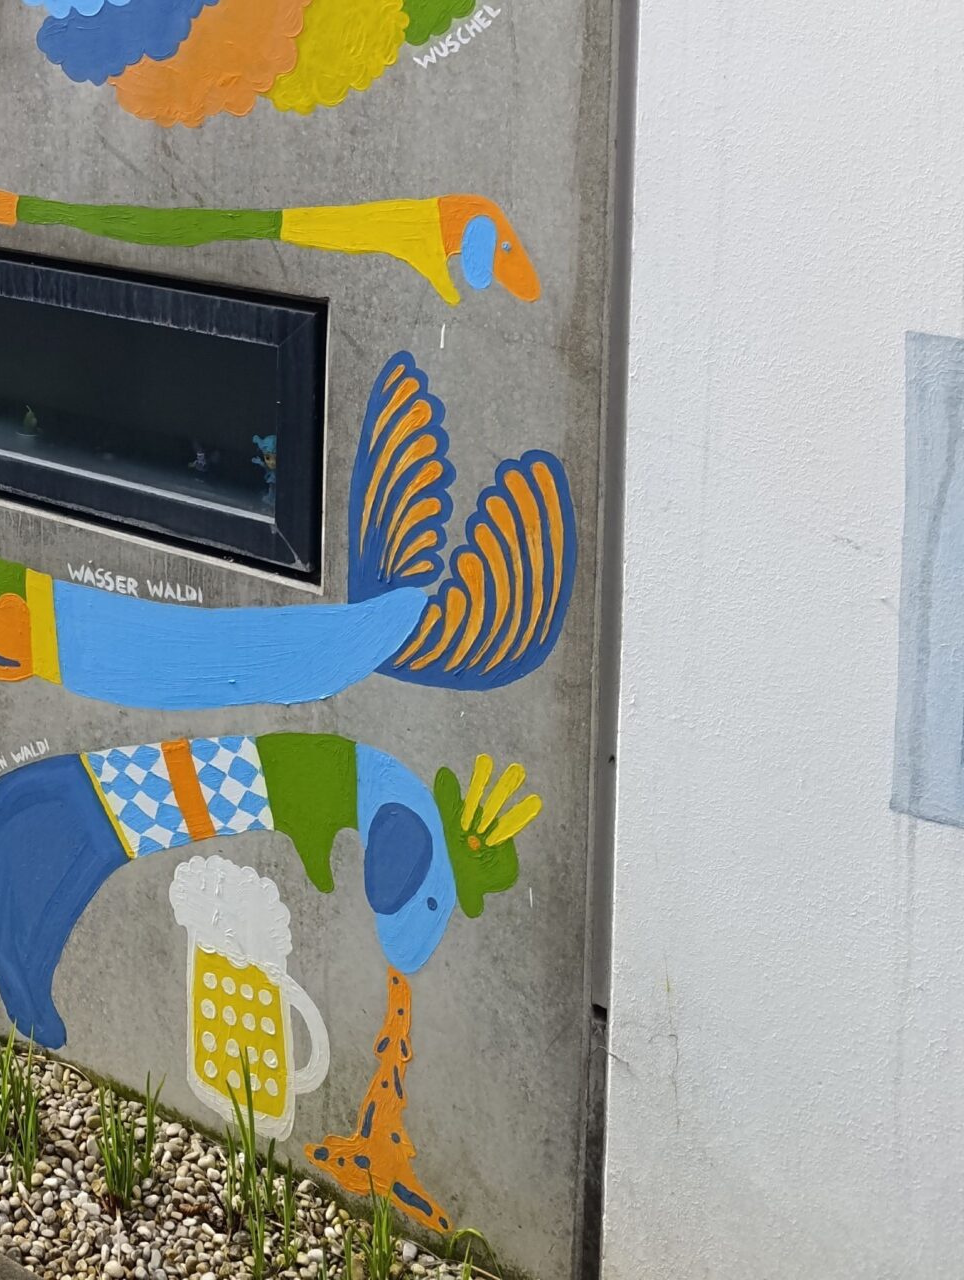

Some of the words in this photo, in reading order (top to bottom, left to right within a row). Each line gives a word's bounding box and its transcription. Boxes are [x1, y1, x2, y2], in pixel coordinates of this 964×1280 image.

[412, 4, 502, 69] WUSCHEL
[146, 579, 204, 604] WALDI
[10, 737, 50, 764] WALDI
